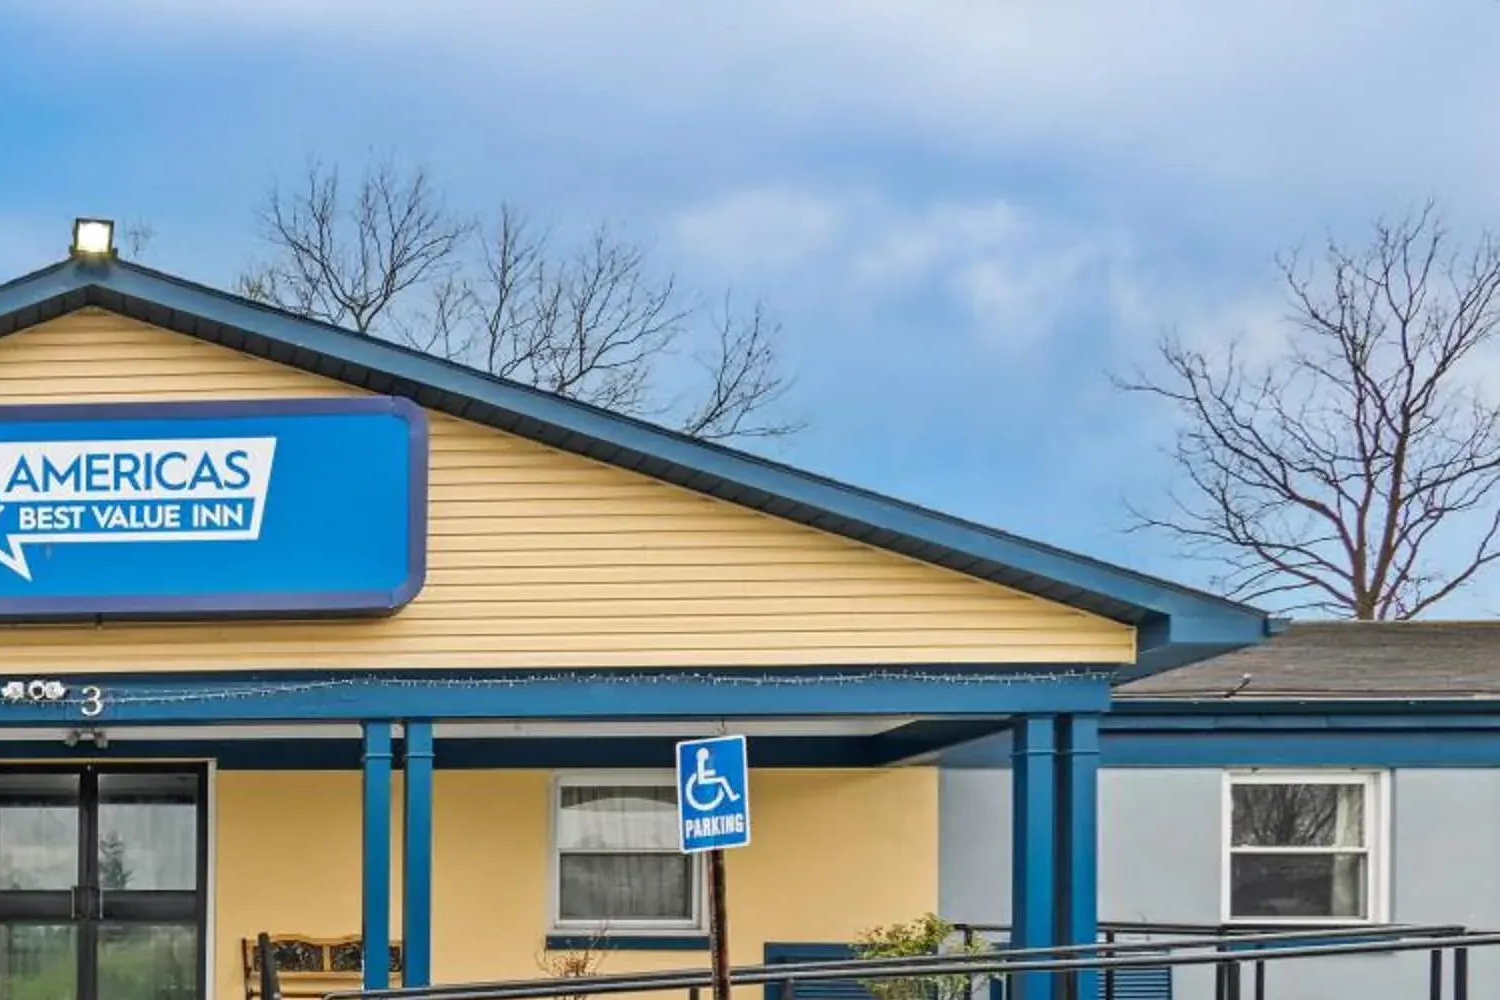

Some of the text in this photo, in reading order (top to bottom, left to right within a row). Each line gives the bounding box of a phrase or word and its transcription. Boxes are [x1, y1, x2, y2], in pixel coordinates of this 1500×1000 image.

[4, 450, 251, 493] AMERICAS
[19, 503, 244, 530] BEST VALUE INN
[81, 685, 103, 716] 3
[685, 812, 745, 839] PARKING
